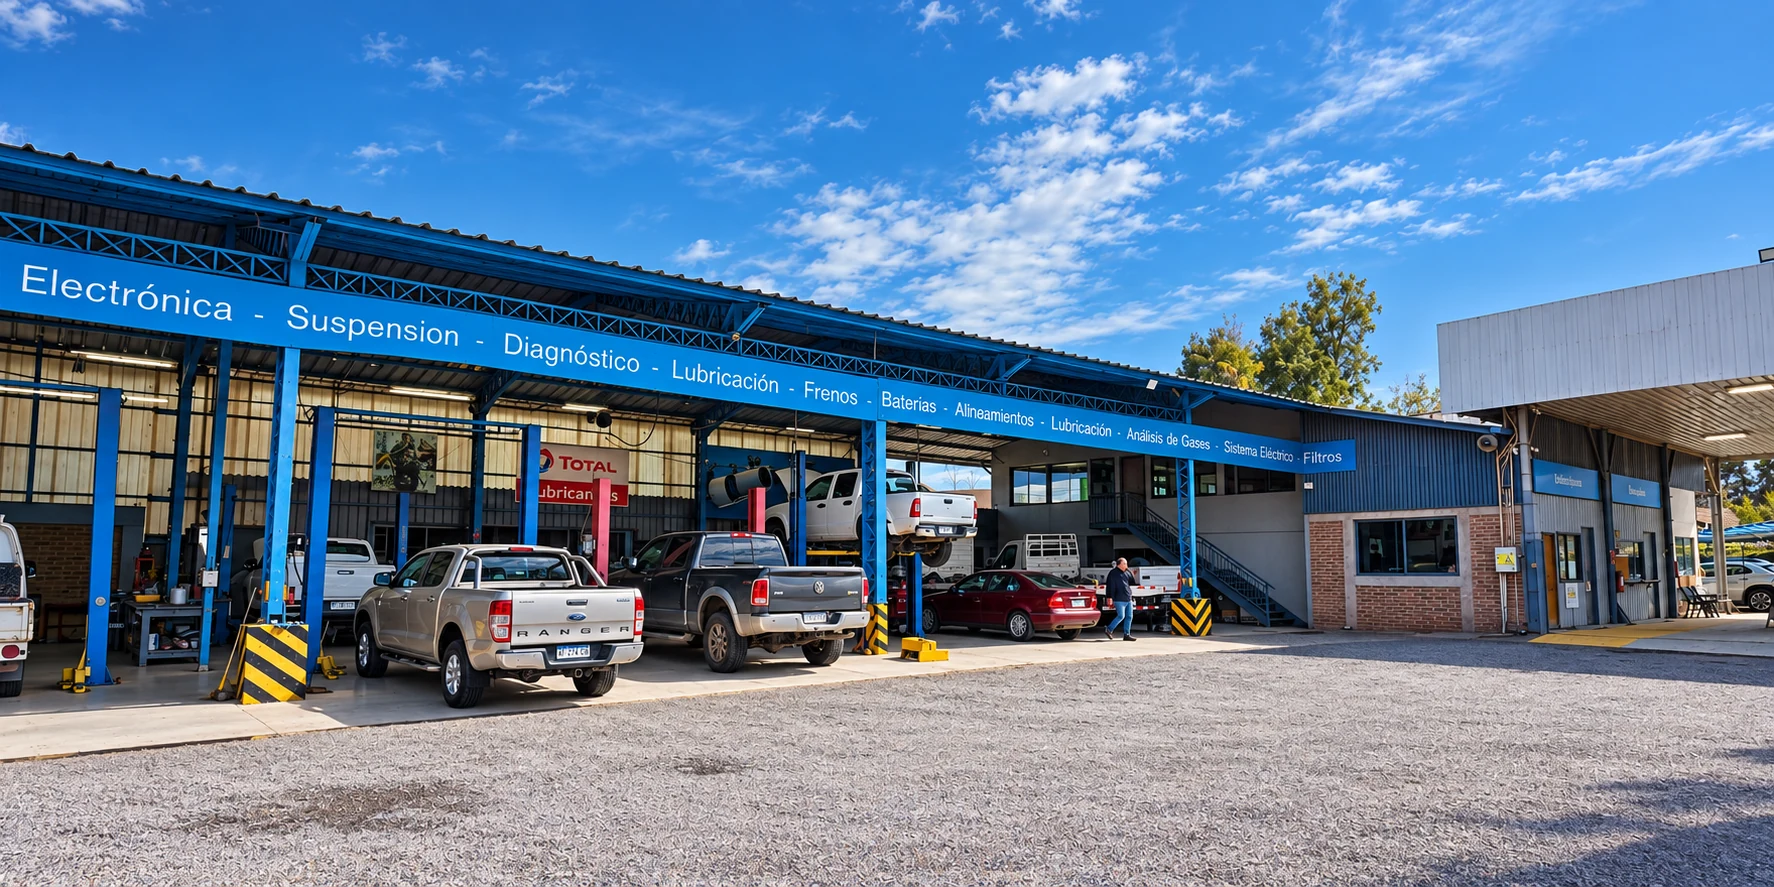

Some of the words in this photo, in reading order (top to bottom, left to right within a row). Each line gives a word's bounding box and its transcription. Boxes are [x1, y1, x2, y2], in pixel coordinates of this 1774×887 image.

[21, 264, 233, 321] Electrónica
[287, 304, 459, 347] Suspension
[504, 332, 640, 373] Diagnóstico
[672, 359, 779, 394] Lubricación
[804, 380, 858, 405] Frenos
[954, 401, 1034, 427] Alineamientos
[1051, 415, 1112, 437] Lubricación
[1126, 427, 1163, 444] Análisis
[1166, 432, 1178, 446] de
[1181, 434, 1211, 450] Gases
[1224, 440, 1258, 457] Sistema
[1260, 445, 1294, 463] Eléctrico
[1303, 451, 1342, 464] Filtros
[558, 455, 617, 473] TOTAL
[538, 485, 618, 502] ubricans
[517, 626, 629, 637] RANGER
